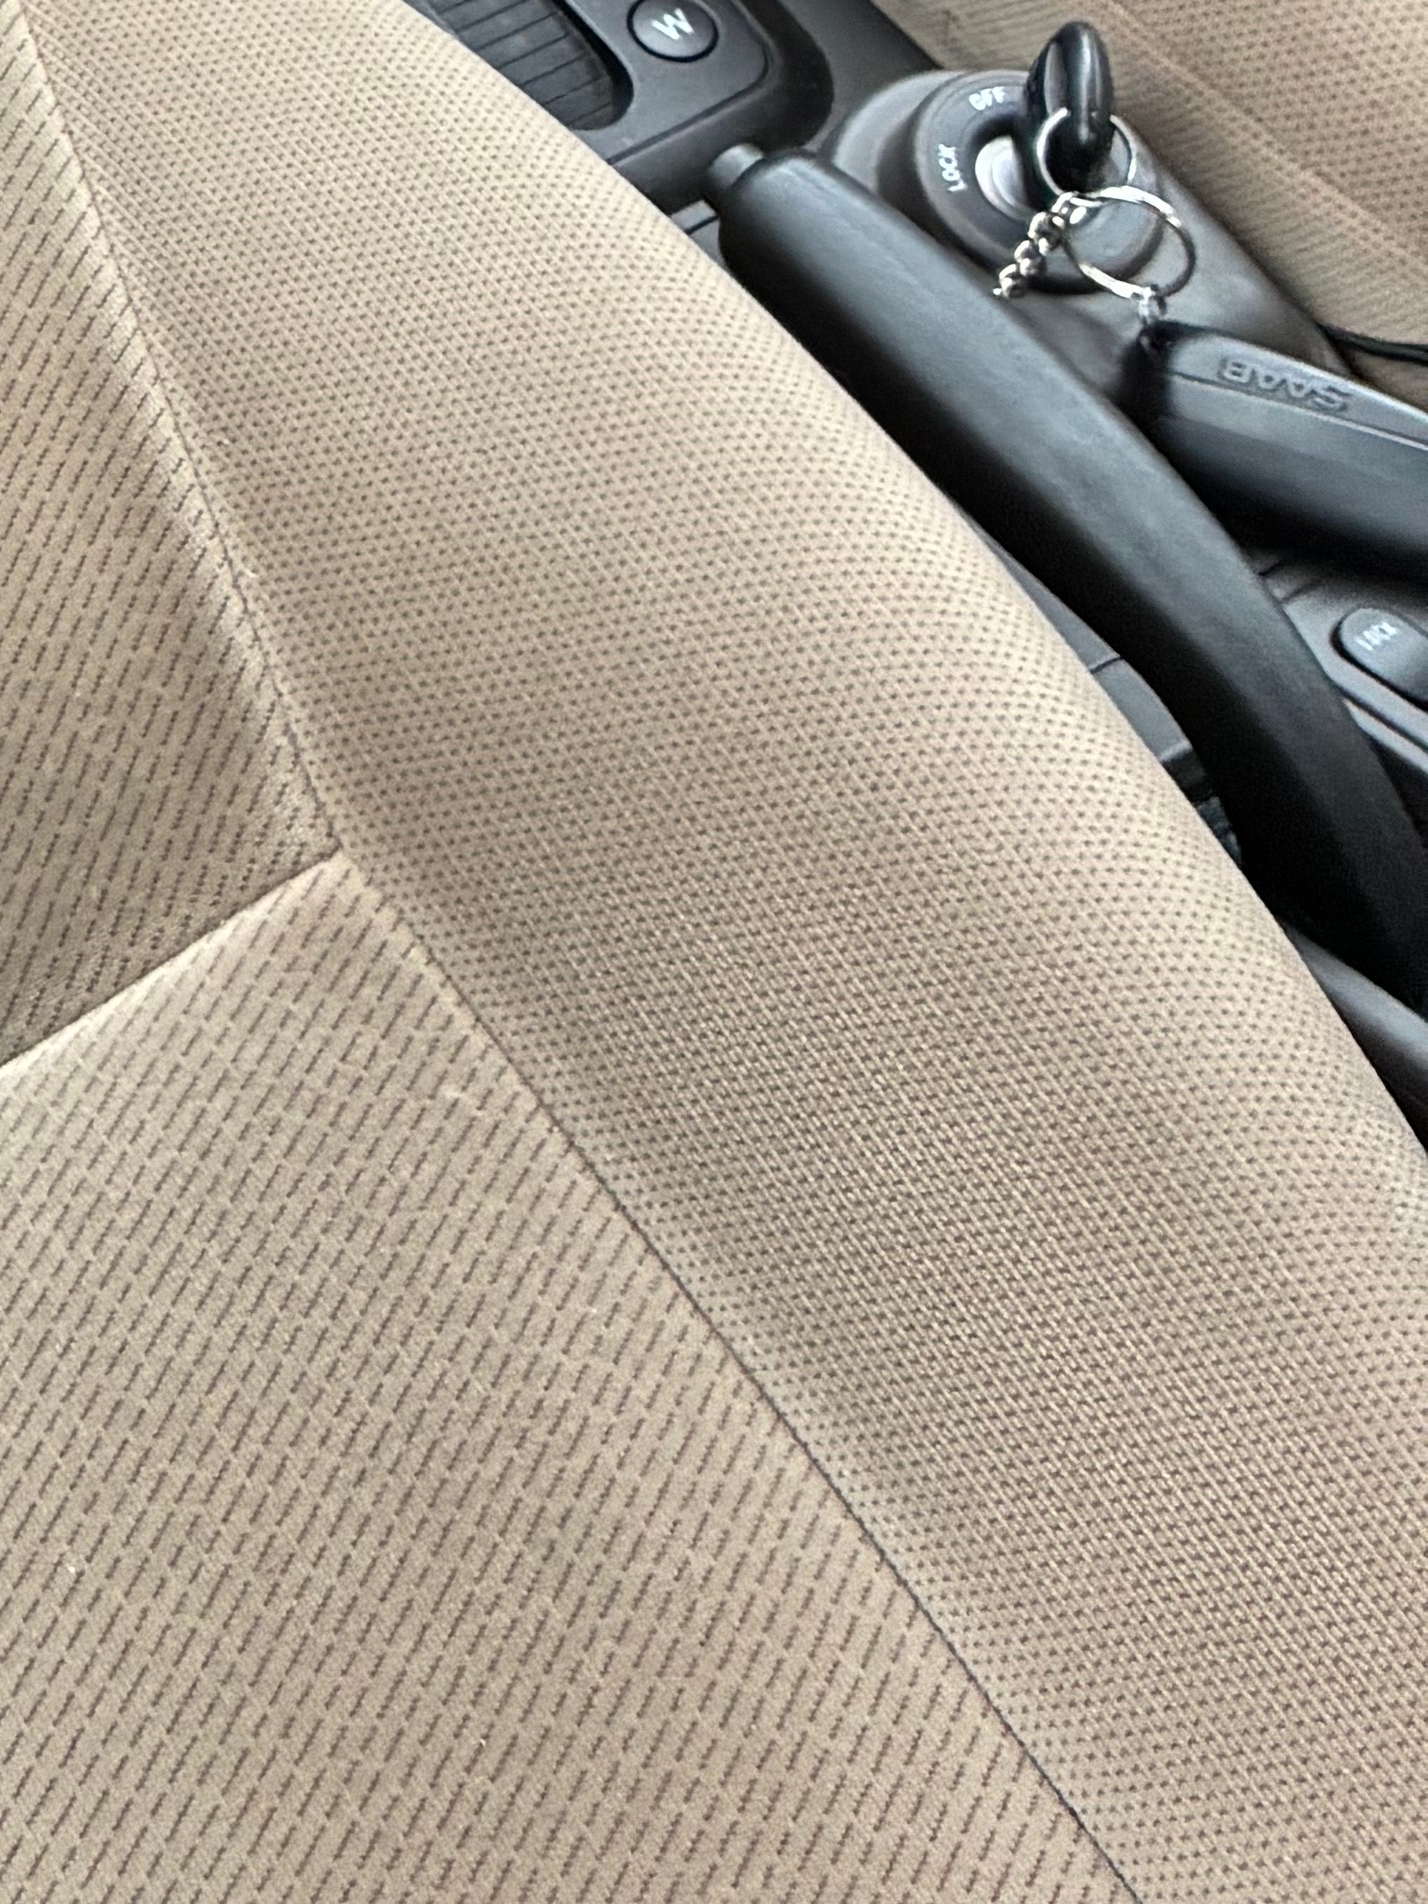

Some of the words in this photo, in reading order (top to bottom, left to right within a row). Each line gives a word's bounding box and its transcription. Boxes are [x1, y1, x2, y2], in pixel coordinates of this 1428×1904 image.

[651, 8, 695, 40] W
[968, 86, 1006, 111] OFF
[938, 143, 968, 193] LOCK
[1217, 356, 1351, 413] SAAB
